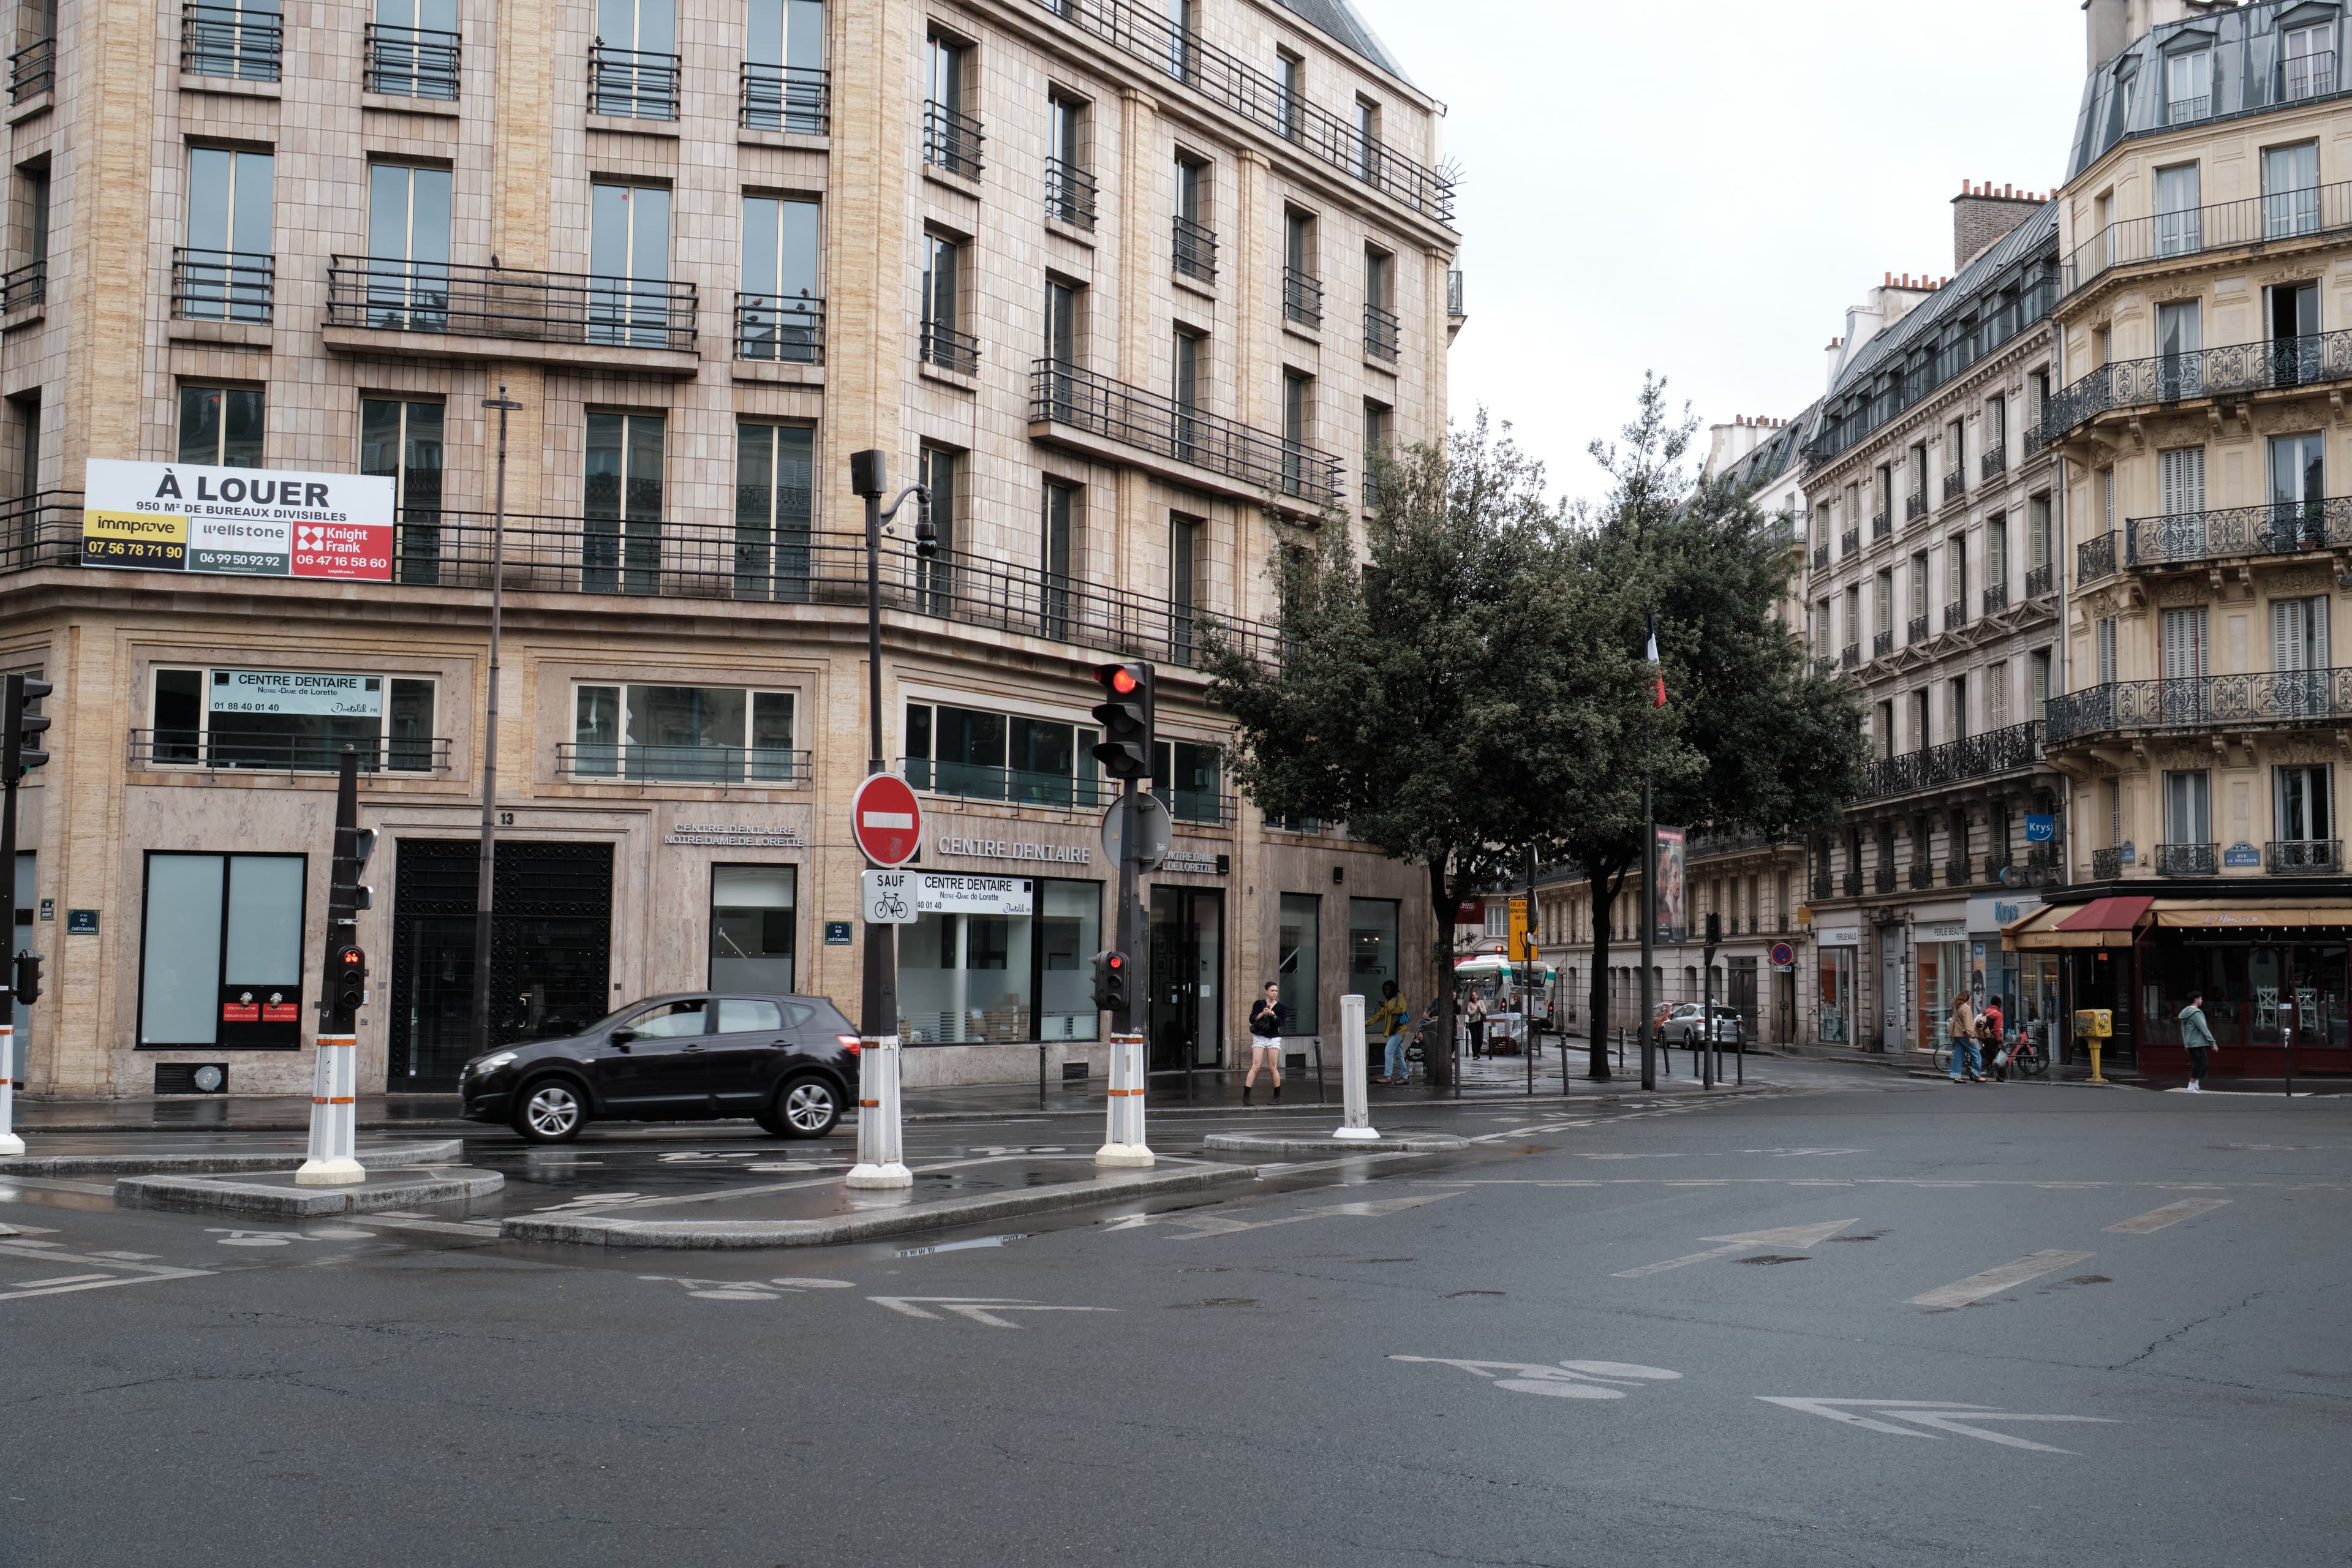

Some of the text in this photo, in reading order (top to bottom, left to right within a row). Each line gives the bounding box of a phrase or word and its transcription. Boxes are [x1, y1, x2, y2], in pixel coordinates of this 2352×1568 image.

[155, 467, 330, 508] À LOUER
[136, 501, 347, 521] 950 M² DE BUREAUX DIVISIBLES
[97, 516, 175, 534] immprove
[203, 524, 285, 538] wellstone
[326, 527, 368, 543] Knight
[88, 541, 183, 559] 07 56 78 71 90
[326, 540, 361, 553] Frank
[200, 552, 280, 567] 06 99 50 92 92
[296, 554, 387, 568] 06 47 16 58 60
[238, 674, 357, 688] CENTRE DENTAIRE
[500, 812, 514, 825] 13
[675, 823, 794, 835] CENTRE DENTAIRE
[2029, 823, 2051, 833] Krys
[665, 835, 804, 846] NOTRE DAME DE LORETTE
[938, 837, 1090, 862] CENTRE DENTAIRE
[1167, 851, 1213, 862] NOTRE DAME
[1167, 861, 1213, 873] DE LORETTE
[877, 875, 905, 887] SAUF
[925, 876, 1012, 892] CENTRE DENTAIRE
[1995, 902, 2018, 924] Krys
[1934, 927, 1948, 937] PERLIE
